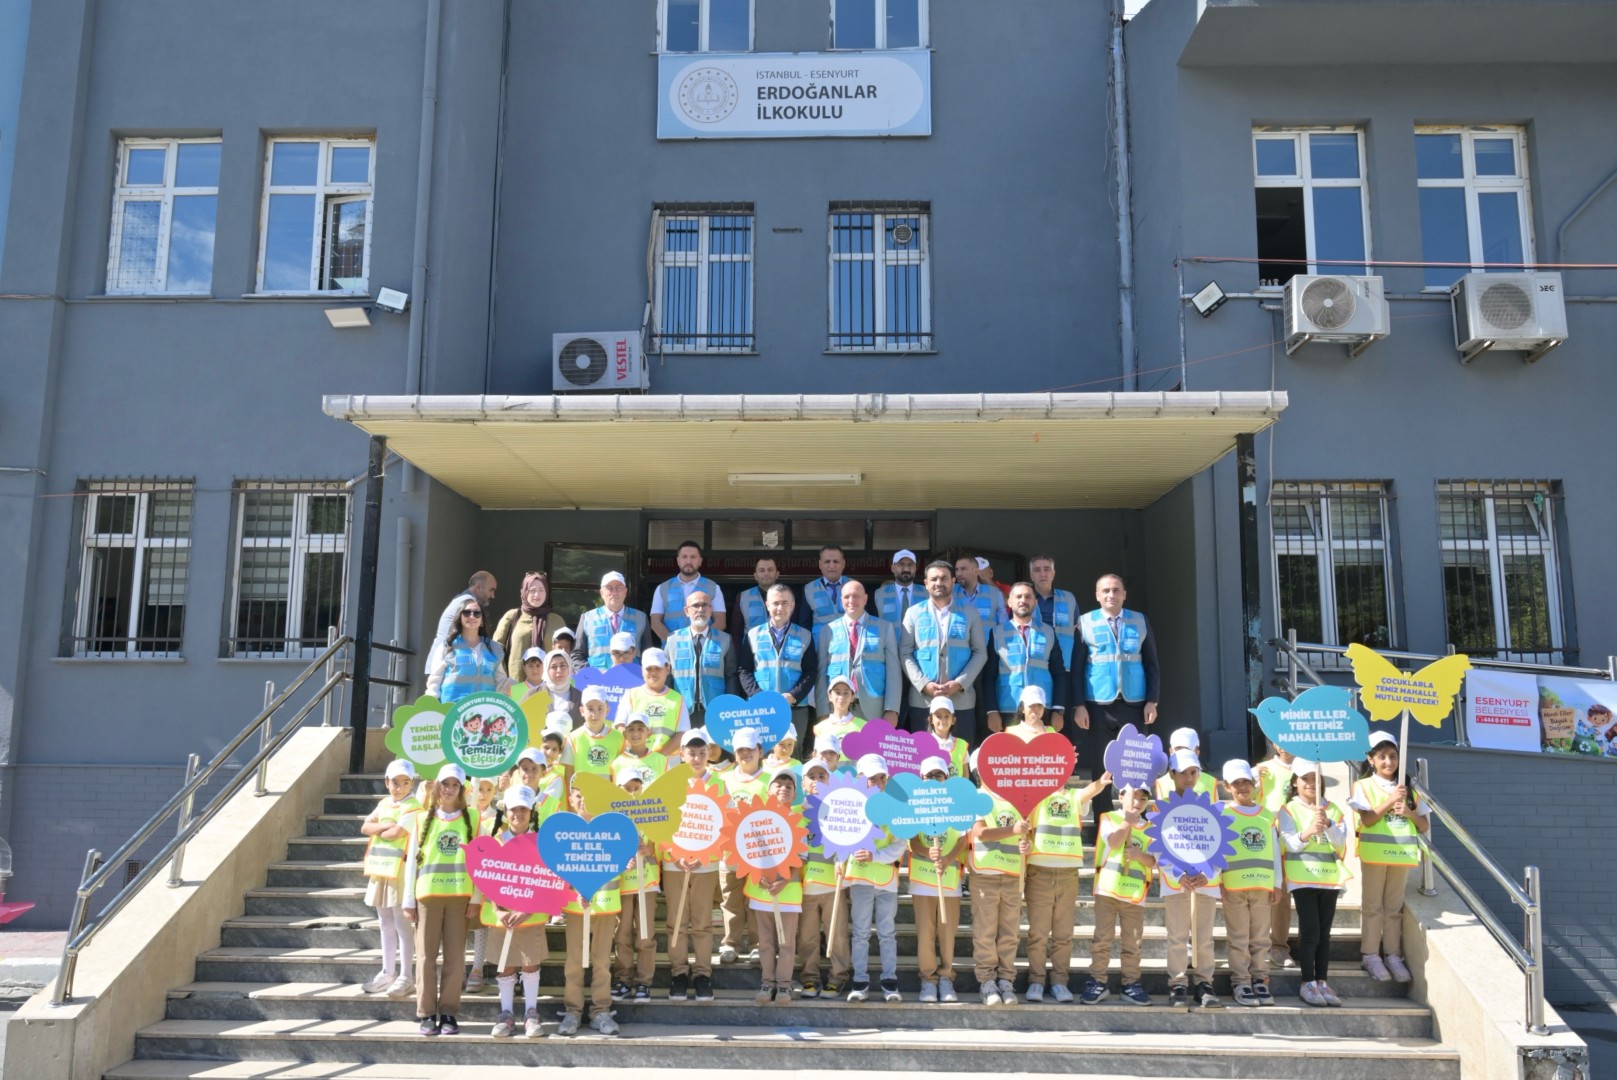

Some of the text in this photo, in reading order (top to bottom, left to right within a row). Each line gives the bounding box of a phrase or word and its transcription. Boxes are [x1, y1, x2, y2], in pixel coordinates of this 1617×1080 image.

[756, 69, 802, 79] İSTANBUL
[810, 70, 860, 79] ESENYURT
[757, 83, 877, 100] ERDOĞANLAR
[757, 104, 842, 120] İLKOKULU
[616, 337, 626, 381] VESTEL
[1381, 678, 1434, 688] ÇOCUKLARLA
[1376, 685, 1399, 693] TEMİZ
[1403, 696, 1439, 705] GELECEK!
[1476, 697, 1529, 708] ESENYURT
[719, 707, 776, 721] ÇOCUKLARLA
[1280, 709, 1350, 720] MİNİK ELLER,
[1476, 707, 1528, 716] BELEDİYESİ
[410, 723, 441, 733] TEMİZLİ
[1289, 719, 1344, 730] TERTEMİZ
[412, 734, 441, 743] SENİNL
[885, 734, 914, 744] BİRLİKTE
[1278, 732, 1356, 742] MAHALLELER!
[460, 744, 506, 756] Temizlik
[470, 754, 496, 764] Elçisi
[988, 754, 1068, 765] BUGÜN TEMİZLİK,
[1022, 766, 1064, 775] SAĞLIKLI
[997, 778, 1058, 787] BİR GELECEK!
[913, 788, 947, 796] BİRLİKTE
[610, 798, 662, 809] ÇOCUKLARLA
[686, 802, 709, 810] TEMİZ
[830, 799, 863, 808] TEMİZLİK
[833, 807, 858, 817] KÜÇÜK
[915, 806, 949, 814] BİRLİKTE
[634, 815, 669, 824] GELECEK!
[682, 812, 714, 822] AHALLE,
[824, 816, 867, 825] ADIMLARLA
[892, 814, 973, 825] GÜZELLEŞTİRİYORUZ!
[1173, 816, 1209, 824] TEMİZLİK
[680, 821, 713, 831] AĞLIKLI
[750, 817, 773, 828] TEMİZ
[744, 827, 782, 839] MAHALLE,
[828, 824, 861, 833] BAŞLAR!
[1178, 824, 1204, 834] KÜÇÜK
[555, 831, 621, 842] ÇOCUKLARLA
[584, 842, 604, 851] ELE,
[746, 837, 784, 849] SAĞLIKLI
[1174, 843, 1210, 851] BAŞLAR!
[564, 851, 611, 861] TEMİZ BİR
[747, 847, 786, 859] GELECEK!
[481, 858, 531, 873] ÇOCUKLAR
[557, 864, 619, 872] MAHALLEYE!
[474, 869, 565, 891] MAHALLE TEMİZLİĞİ
[500, 886, 534, 899] GÜÇLÜ!
